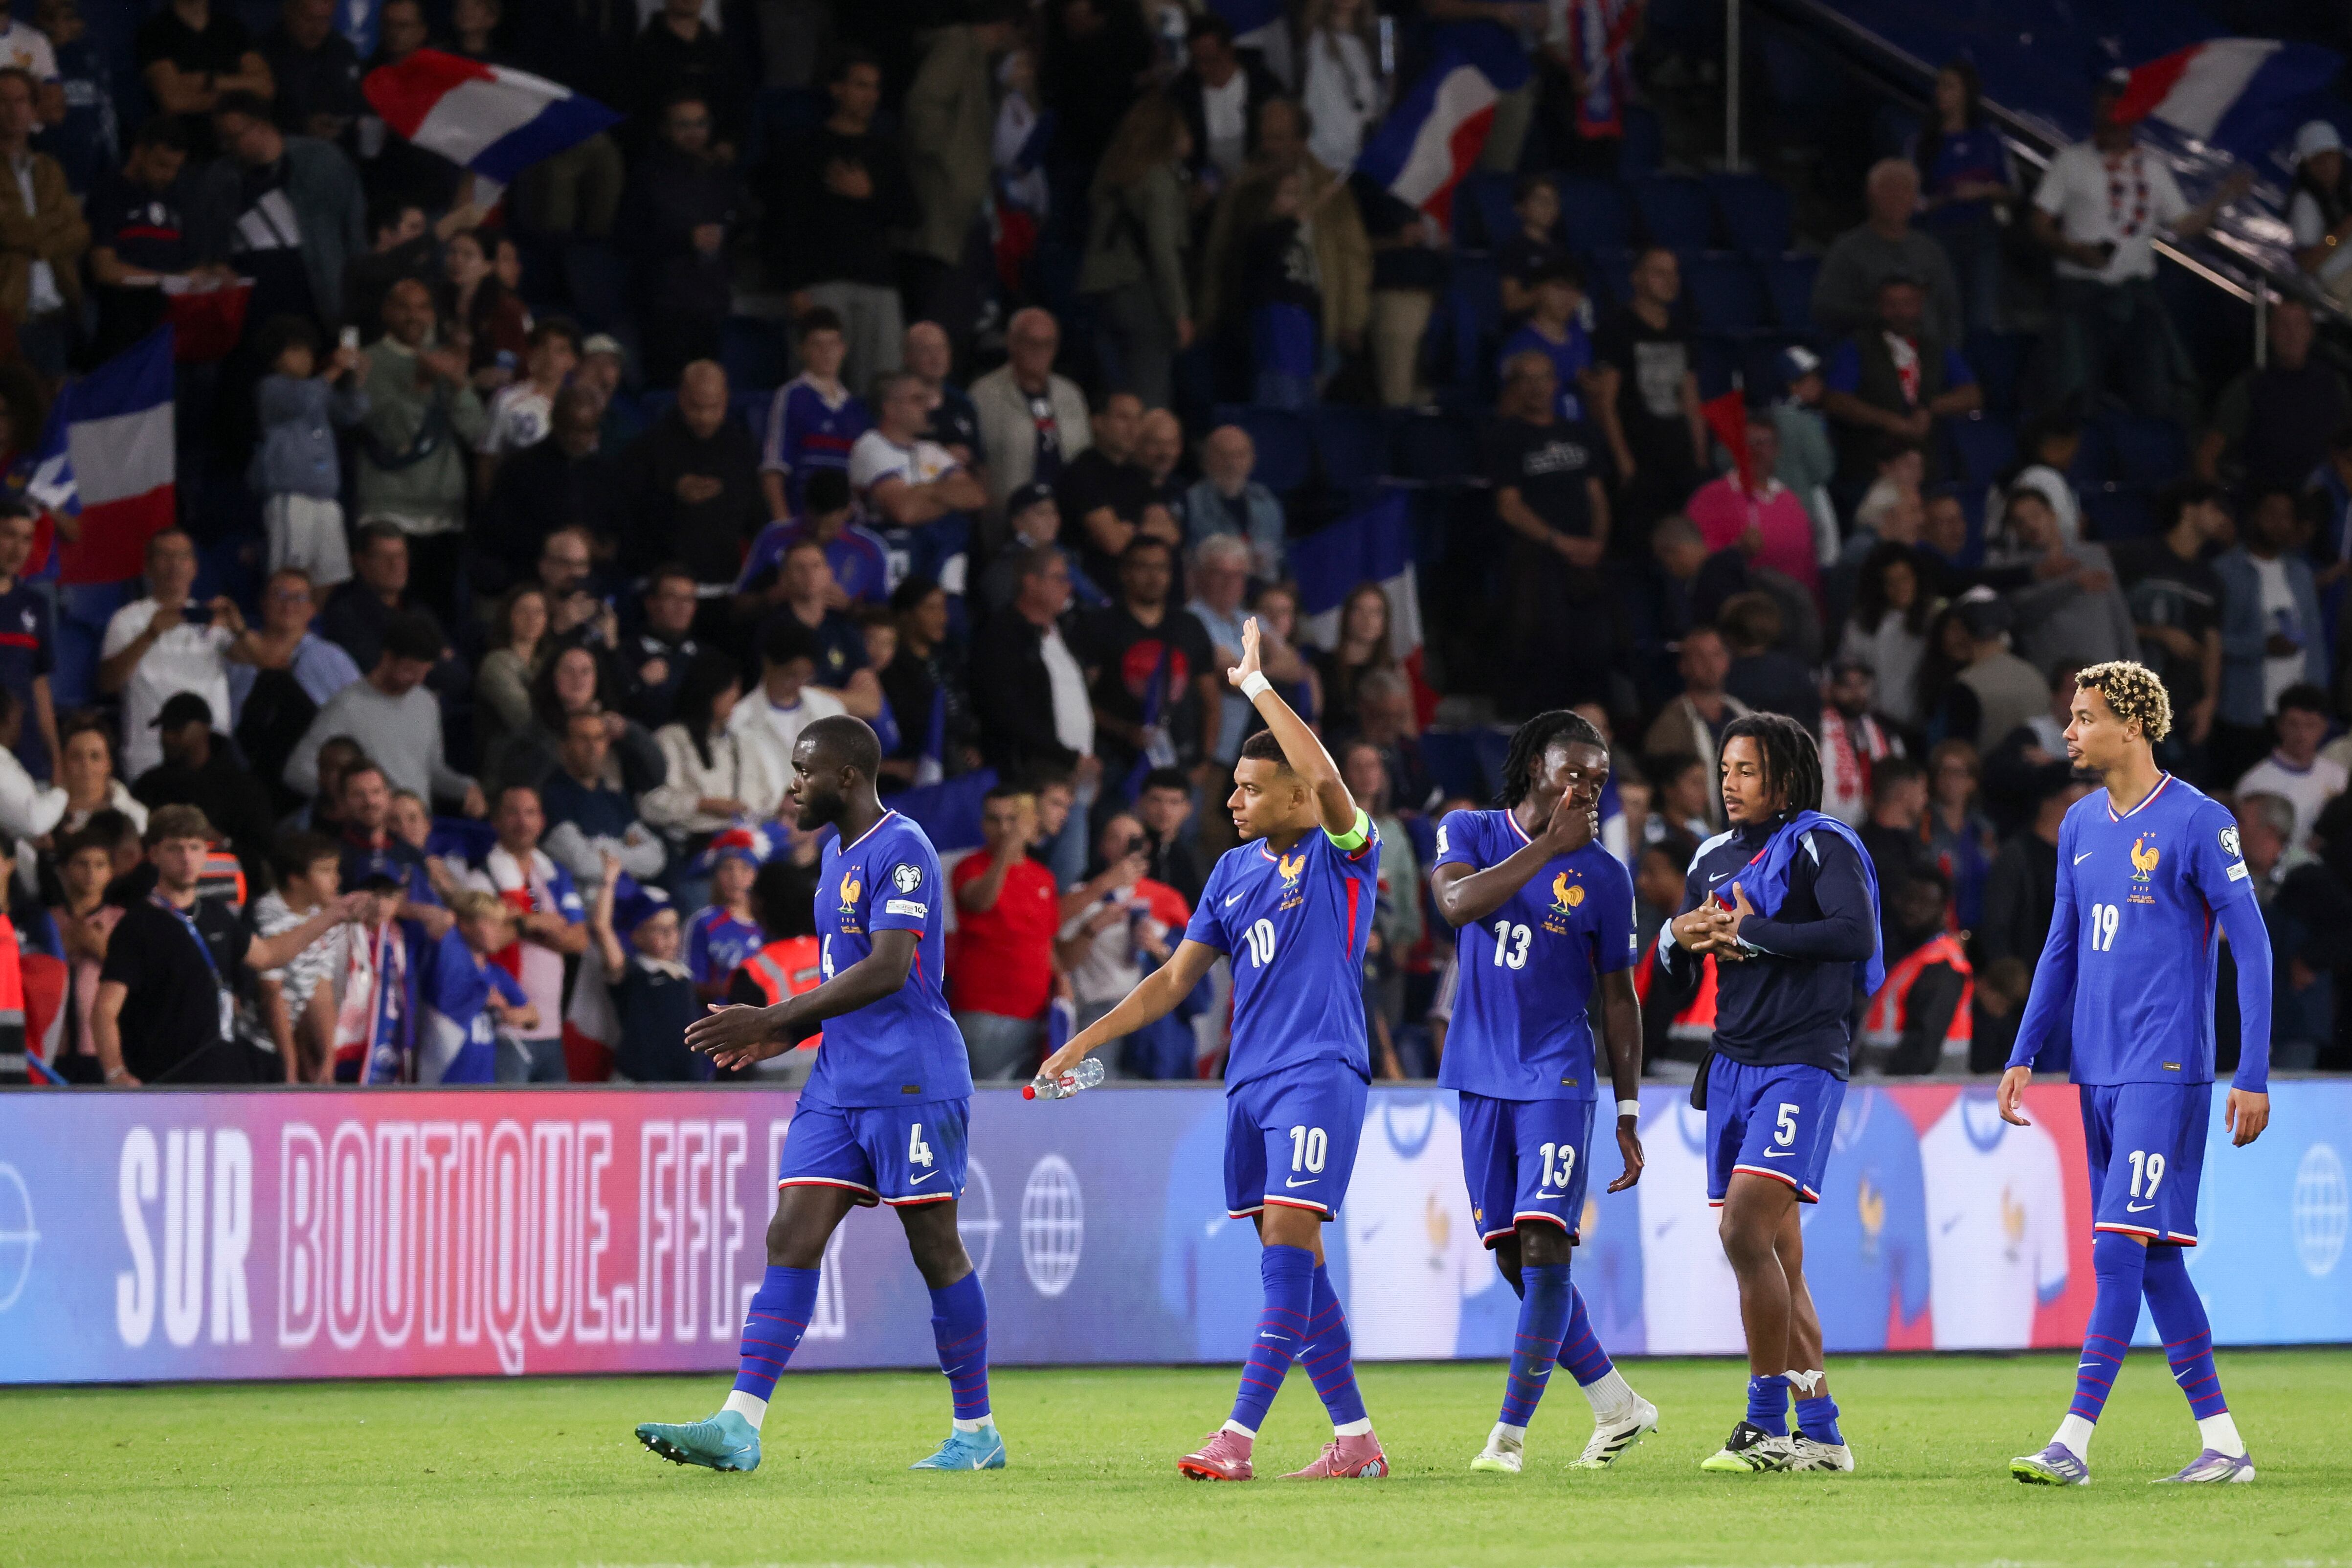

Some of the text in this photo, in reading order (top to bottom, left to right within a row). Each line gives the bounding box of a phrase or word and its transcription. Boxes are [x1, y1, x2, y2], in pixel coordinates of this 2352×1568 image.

[1242, 918, 1275, 968] 10
[1494, 920, 1532, 969] 13
[2092, 903, 2119, 951] 19
[822, 933, 835, 979] 4
[909, 1123, 933, 1167] 4
[1774, 1103, 1800, 1146] 5
[1290, 1125, 1327, 1173] 10
[1540, 1142, 1575, 1188] 13
[2128, 1150, 2165, 1199] 19
[117, 1125, 252, 1347] SUR
